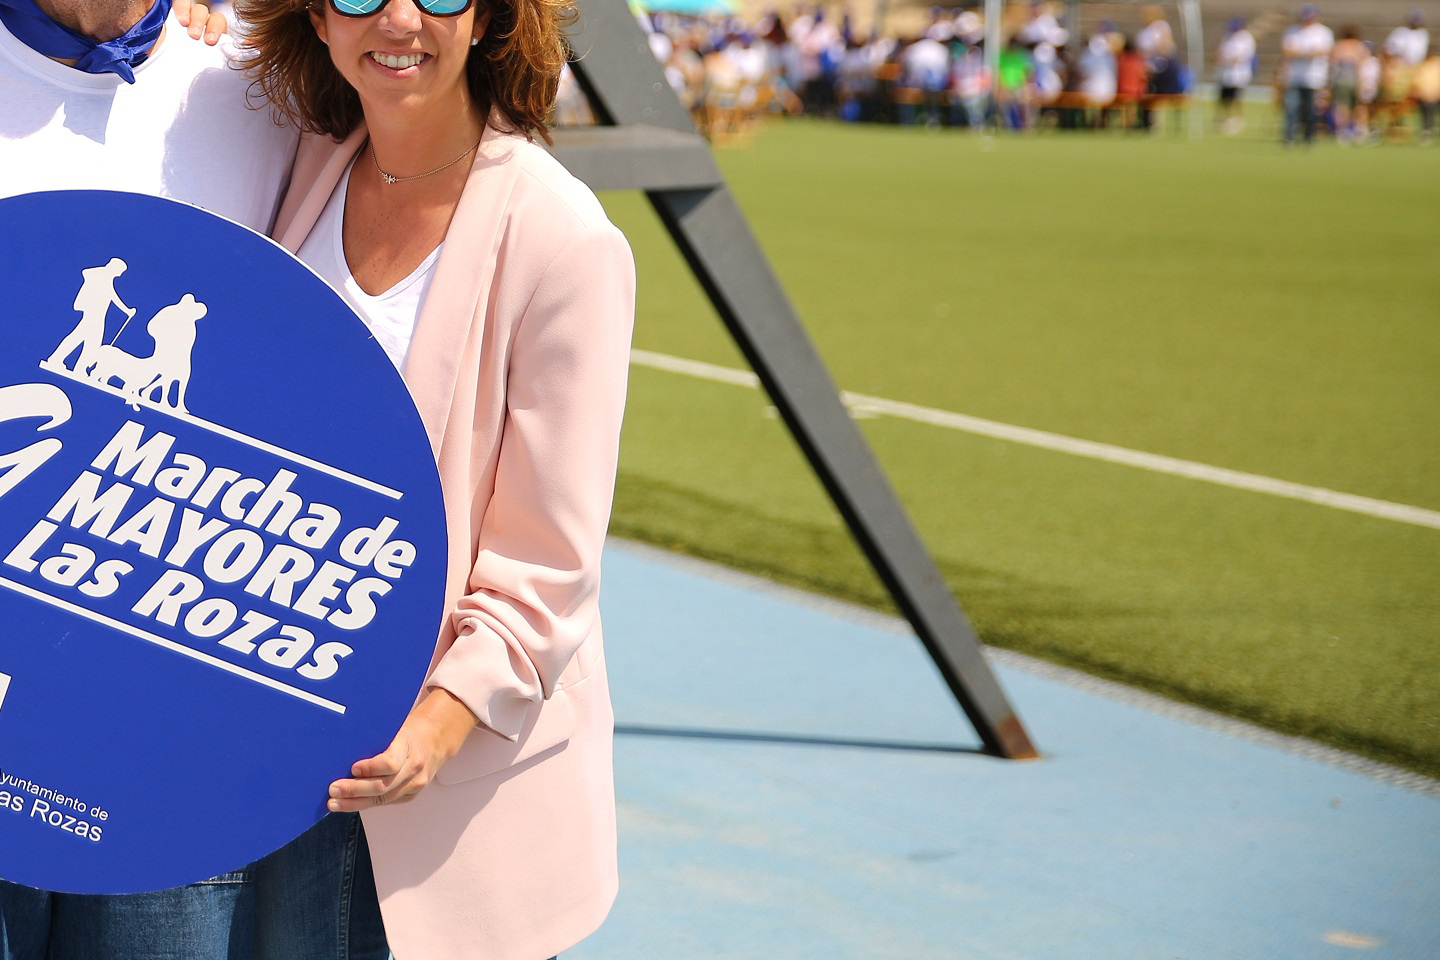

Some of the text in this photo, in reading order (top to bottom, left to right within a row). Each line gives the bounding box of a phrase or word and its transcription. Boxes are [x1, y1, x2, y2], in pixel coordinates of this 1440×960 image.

[46, 470, 392, 630] MAYORES
[91, 420, 416, 578] Marcha de
[3, 520, 353, 680] Las Rozas
[30, 798, 103, 842] Rozas
[90, 805, 109, 821] de
